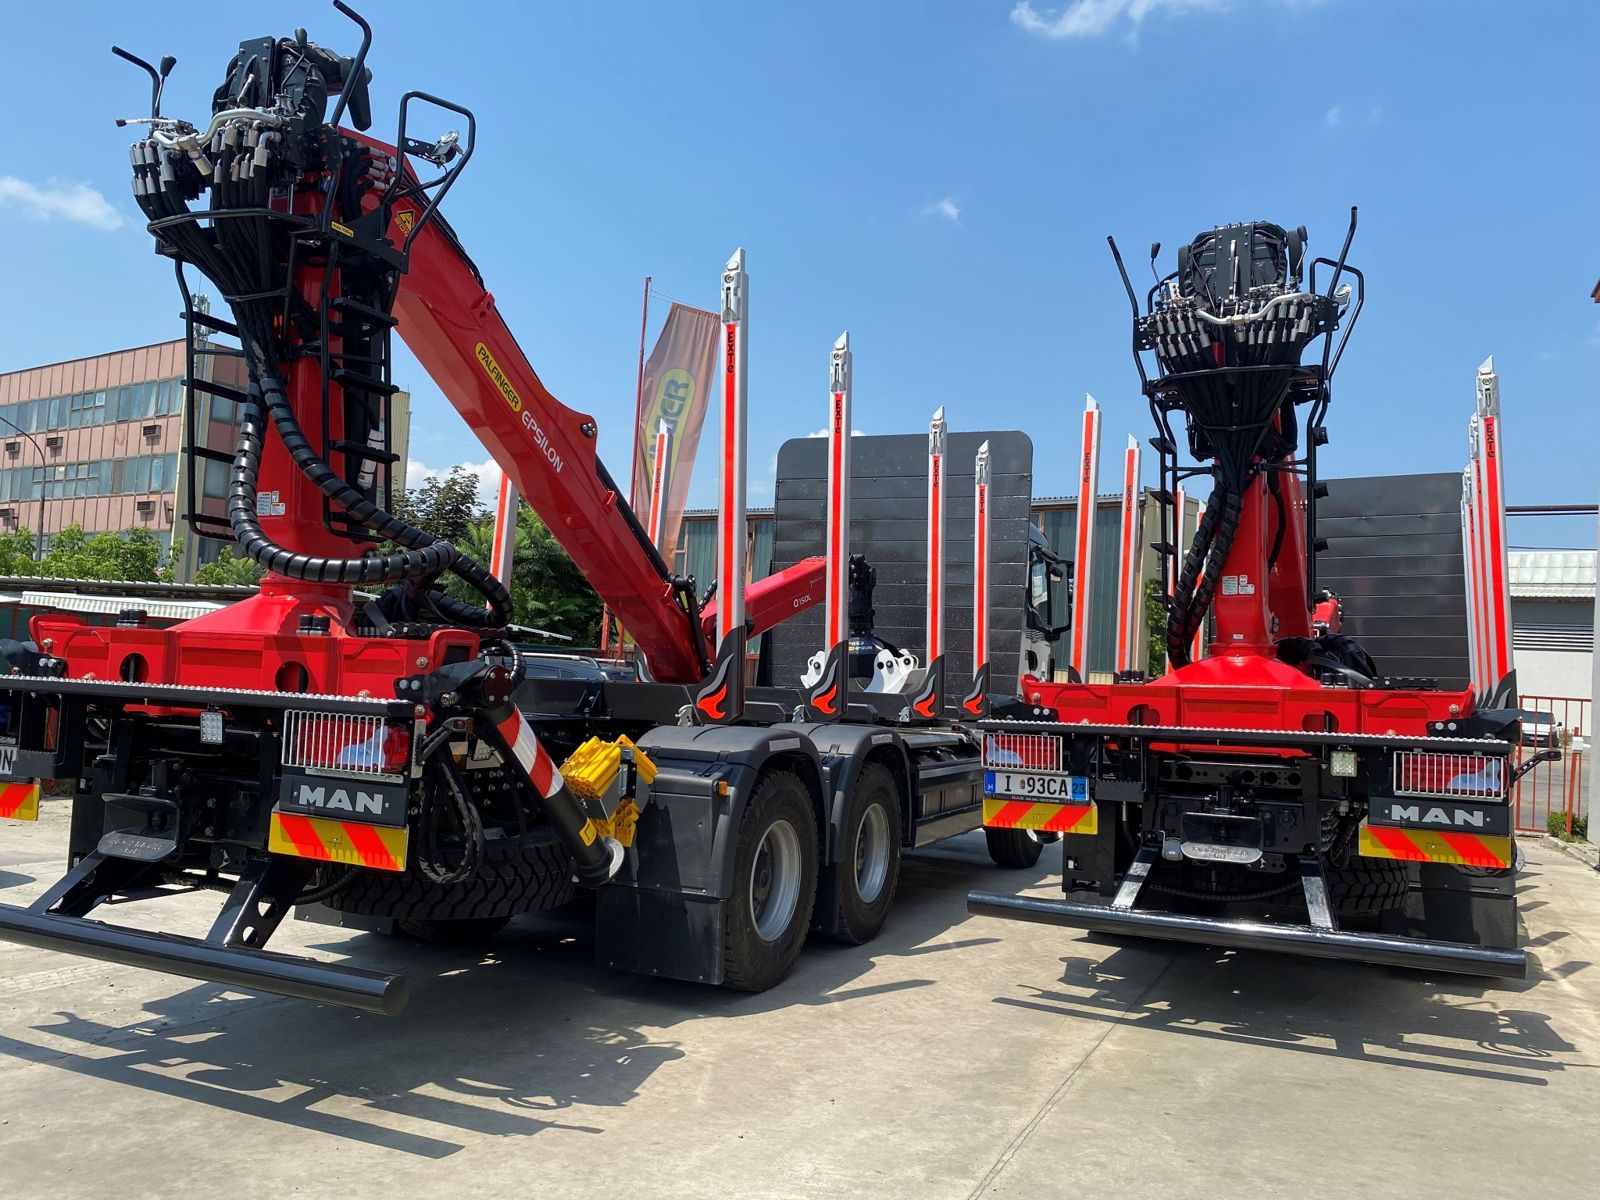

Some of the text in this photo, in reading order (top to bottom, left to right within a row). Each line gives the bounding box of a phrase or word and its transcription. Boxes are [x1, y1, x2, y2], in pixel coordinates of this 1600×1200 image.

[478, 346, 564, 473] PALFINGER EPSILON
[299, 784, 384, 815] MAN
[1026, 776, 1068, 796] 93CA
[1073, 782, 1086, 794] 23
[1391, 804, 1484, 827] MAN
